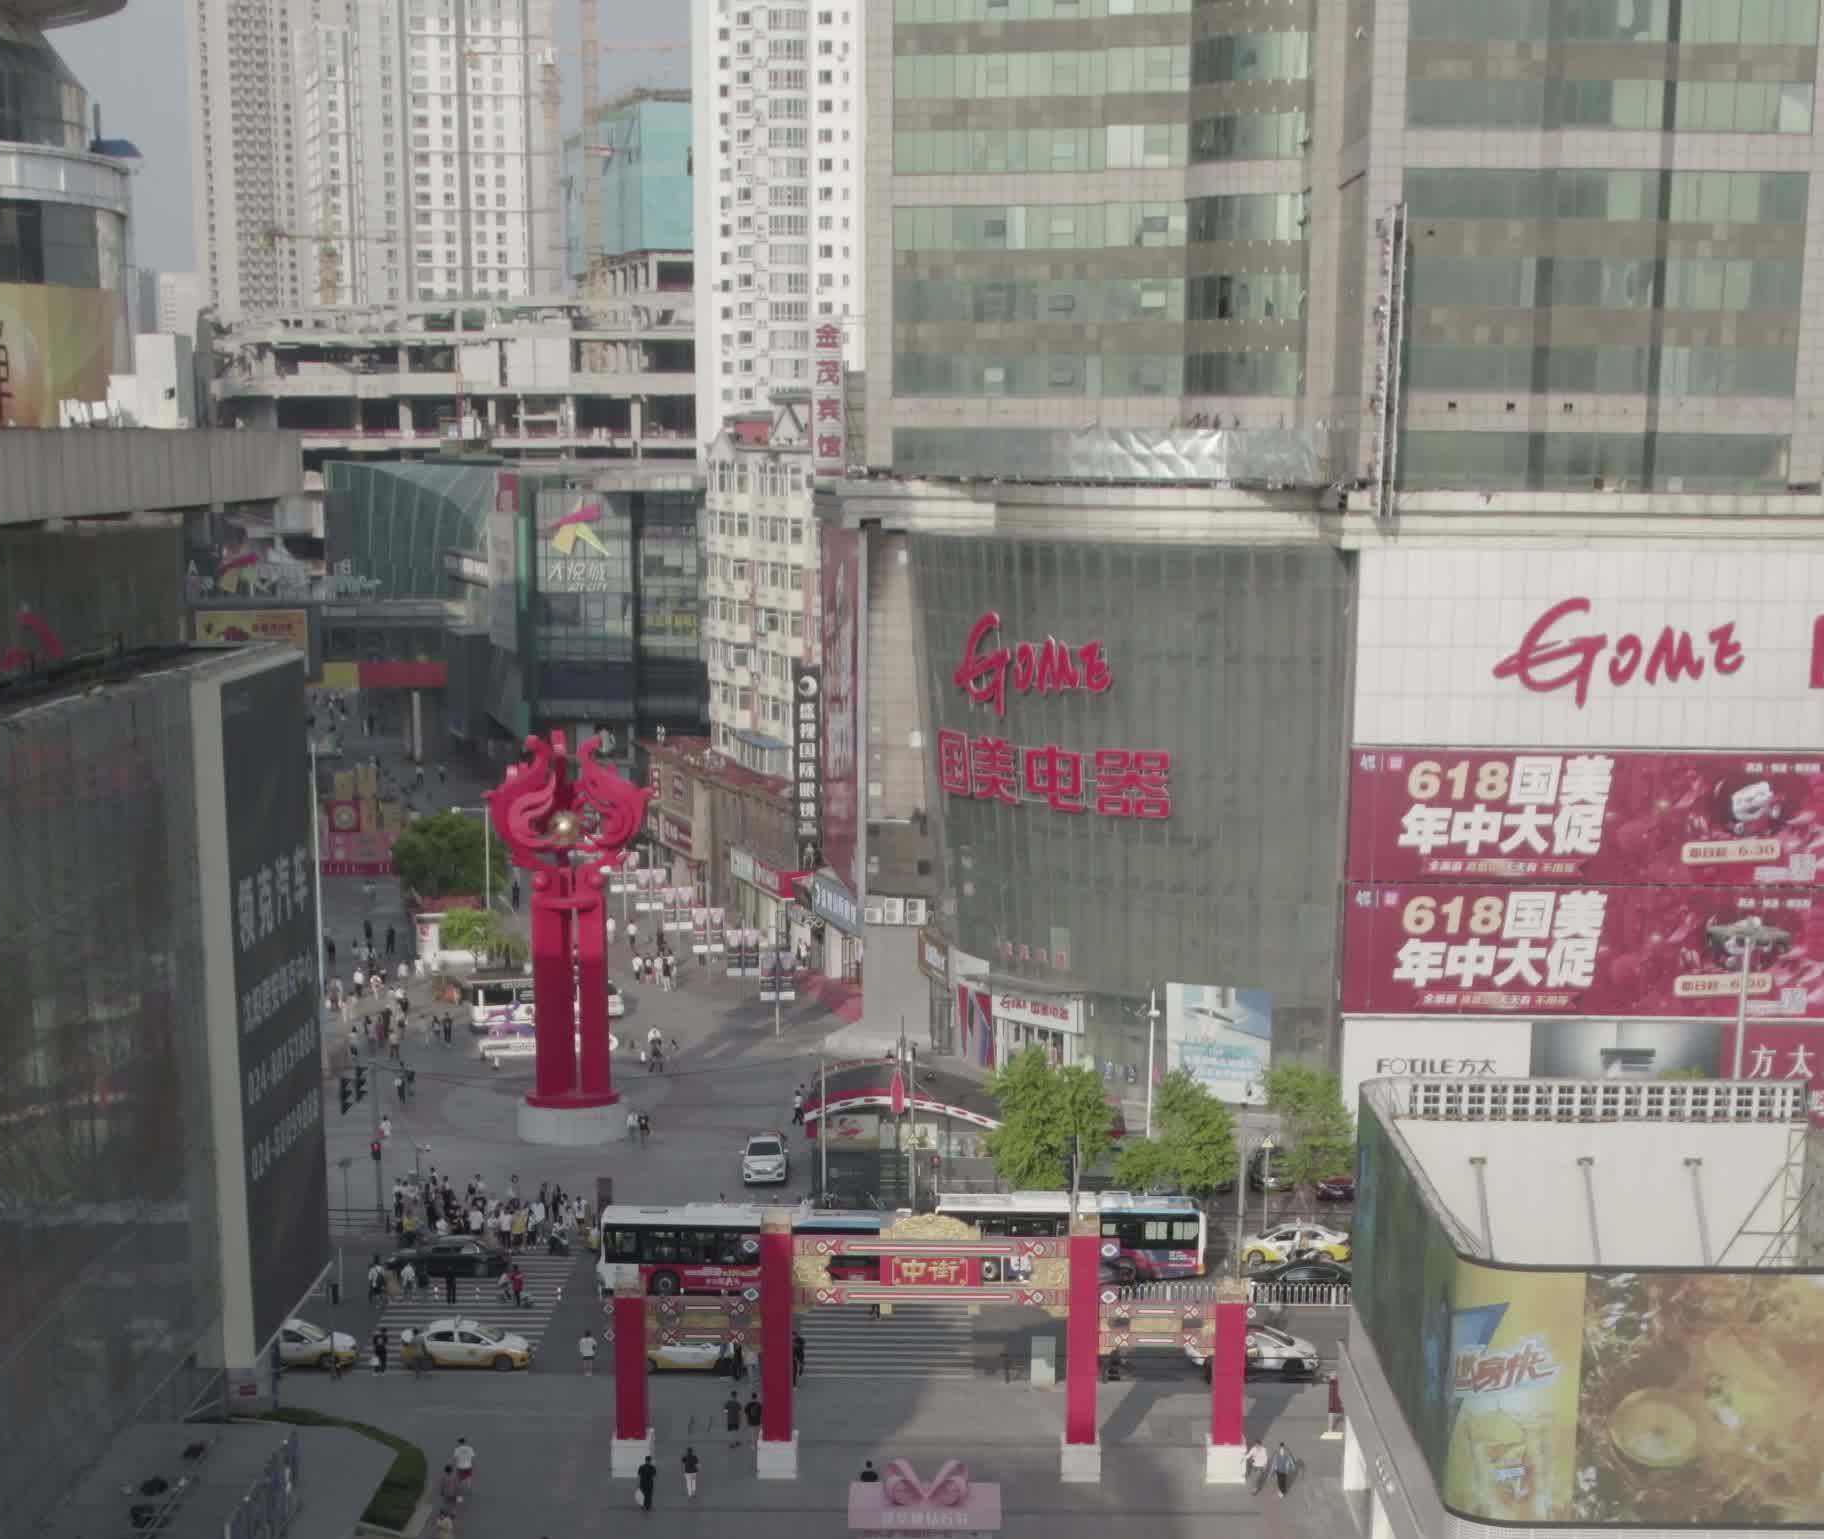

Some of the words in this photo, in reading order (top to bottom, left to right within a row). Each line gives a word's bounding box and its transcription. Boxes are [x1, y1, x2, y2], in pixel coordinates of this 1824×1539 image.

[937, 728, 1172, 819] 国美电器
[1406, 755, 1614, 806] 618国美
[1397, 804, 1607, 855] 年中大促
[1402, 891, 1608, 938] 618国美
[1393, 938, 1602, 988] 年中大促
[1375, 1057, 1457, 1075] FOTILE
[1457, 1057, 1497, 1074] 方太
[901, 1259, 961, 1283] 中街
